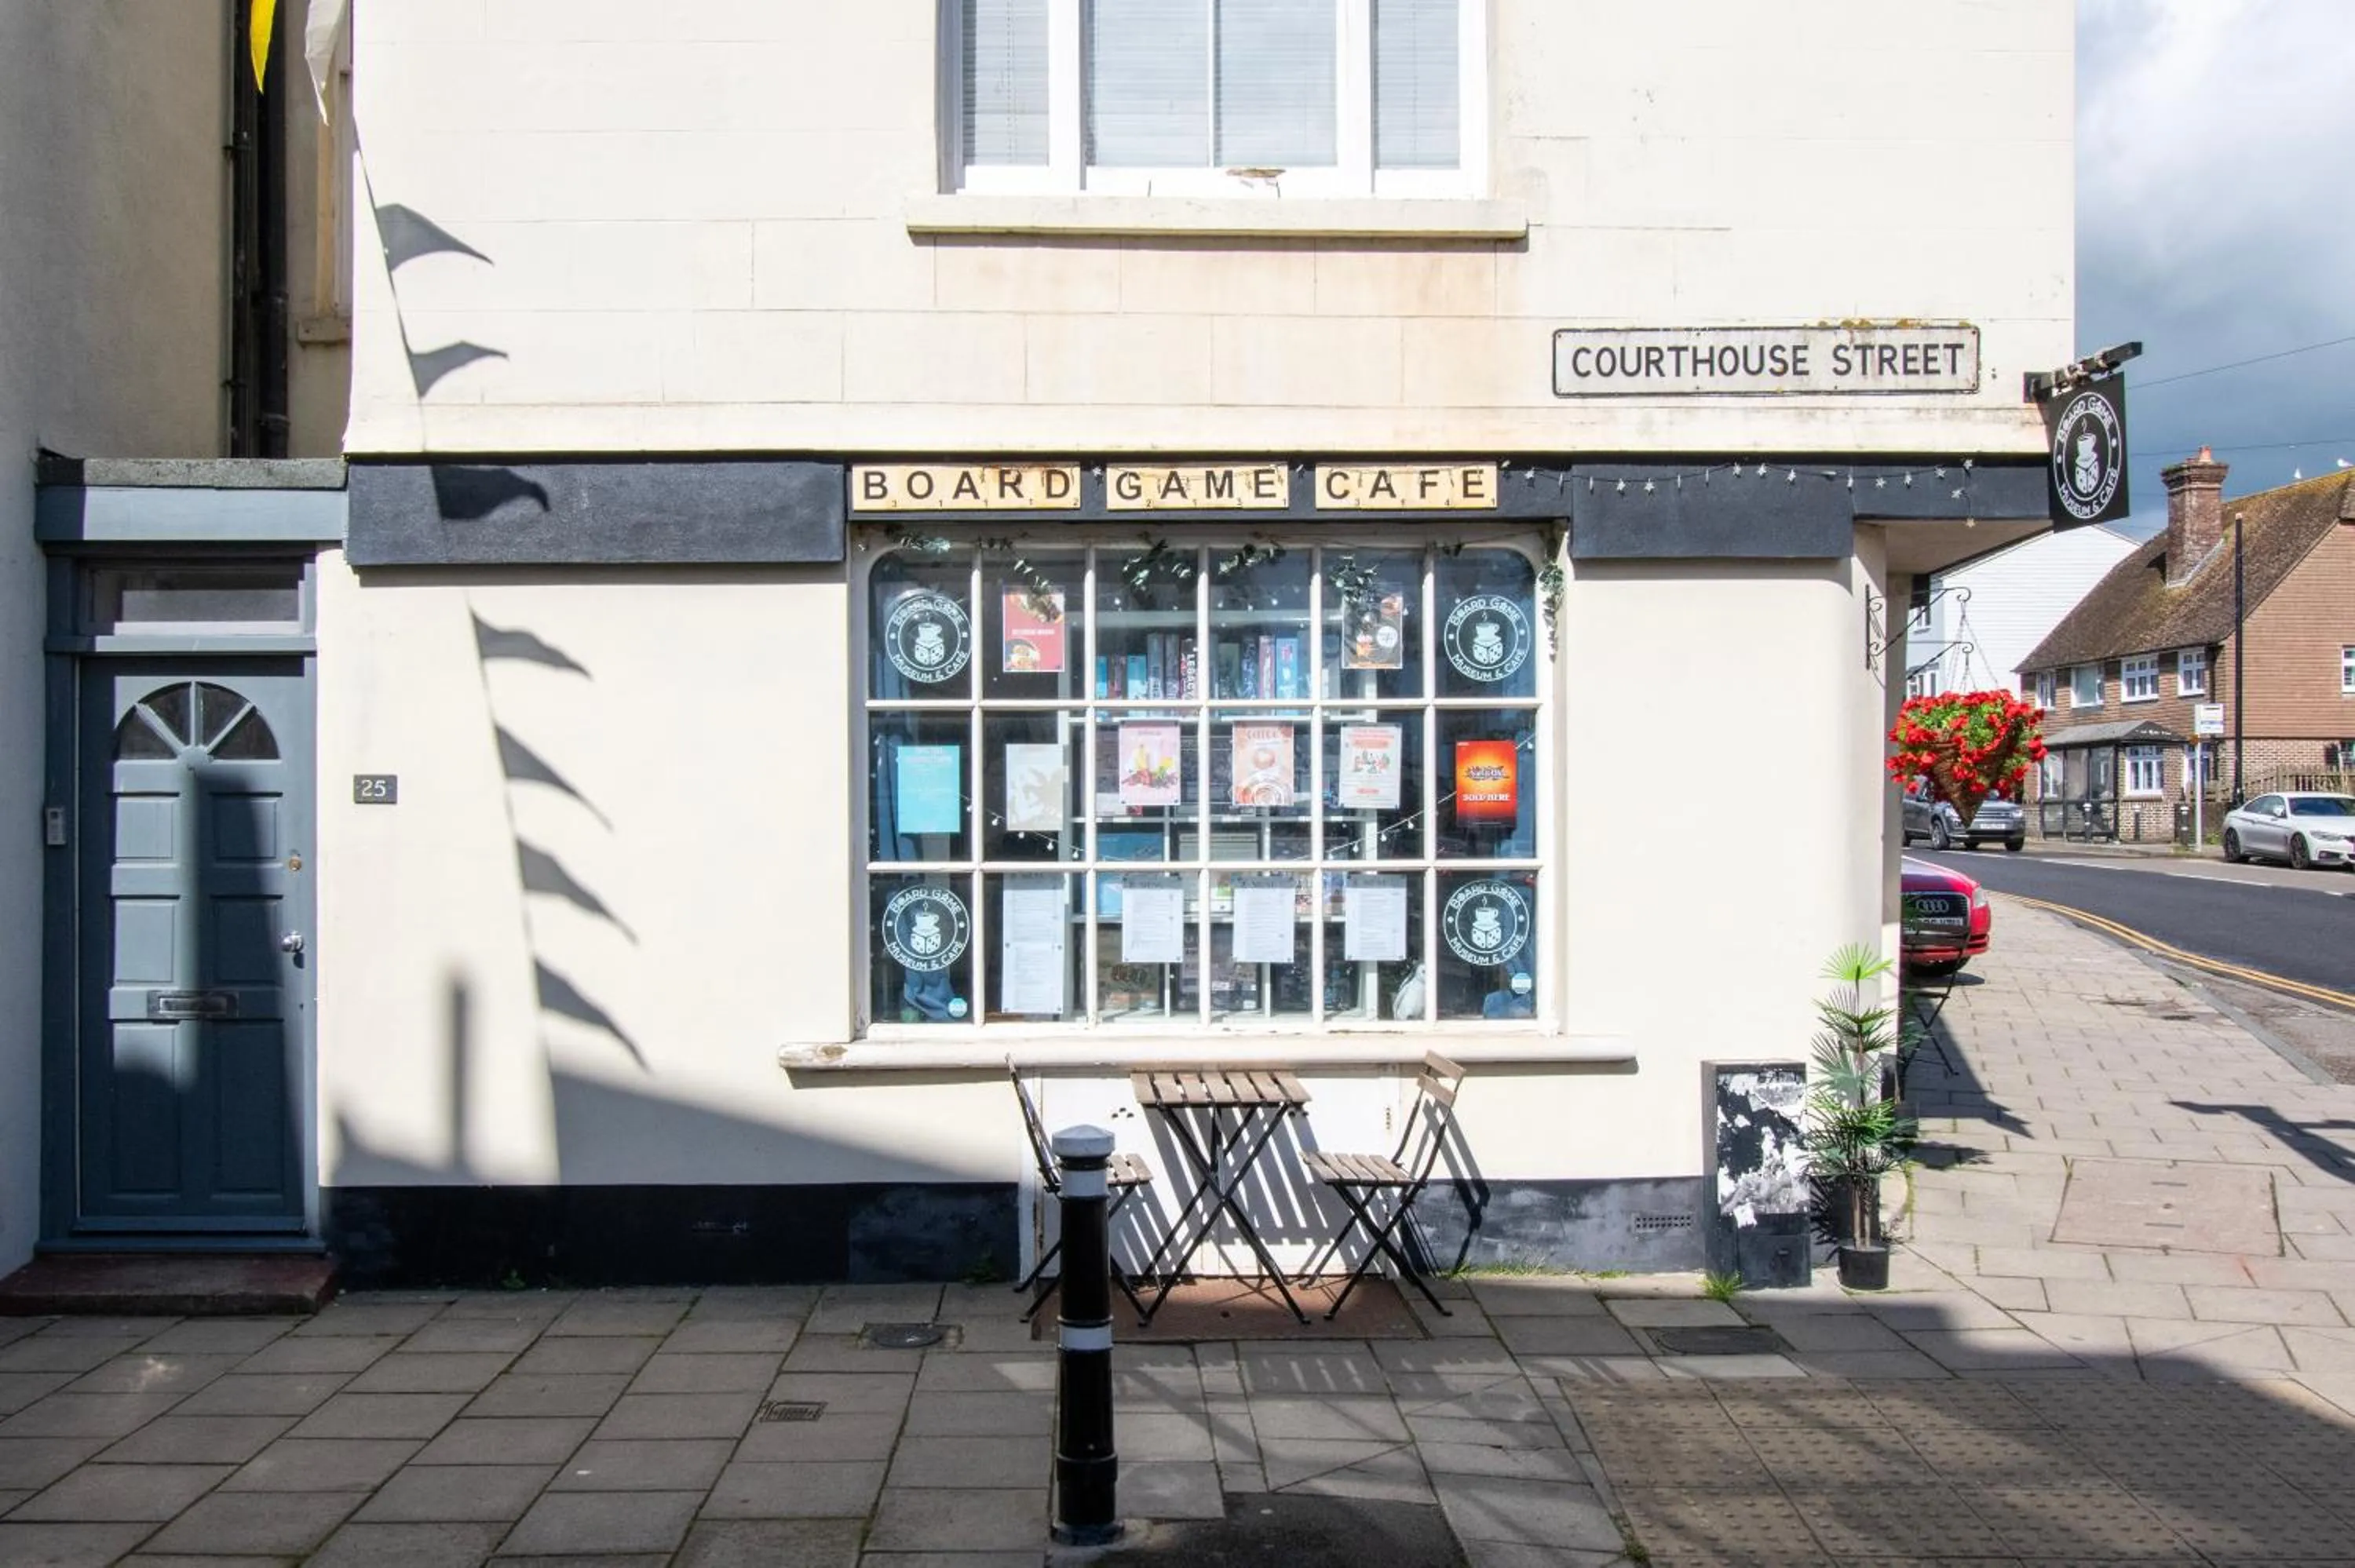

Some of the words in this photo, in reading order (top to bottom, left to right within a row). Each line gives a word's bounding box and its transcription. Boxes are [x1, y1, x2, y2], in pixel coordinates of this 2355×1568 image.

[1572, 344, 1810, 378] COURTHOUSE
[1831, 342, 1965, 376] STREET
[864, 469, 1071, 499] BOARD
[1115, 469, 1277, 499] GAME
[1325, 469, 1485, 499] CAFE
[1449, 598, 1486, 626] BOARD
[1490, 598, 1521, 622] GAME
[1451, 654, 1492, 680] MUSEUM
[361, 779, 386, 797] 25
